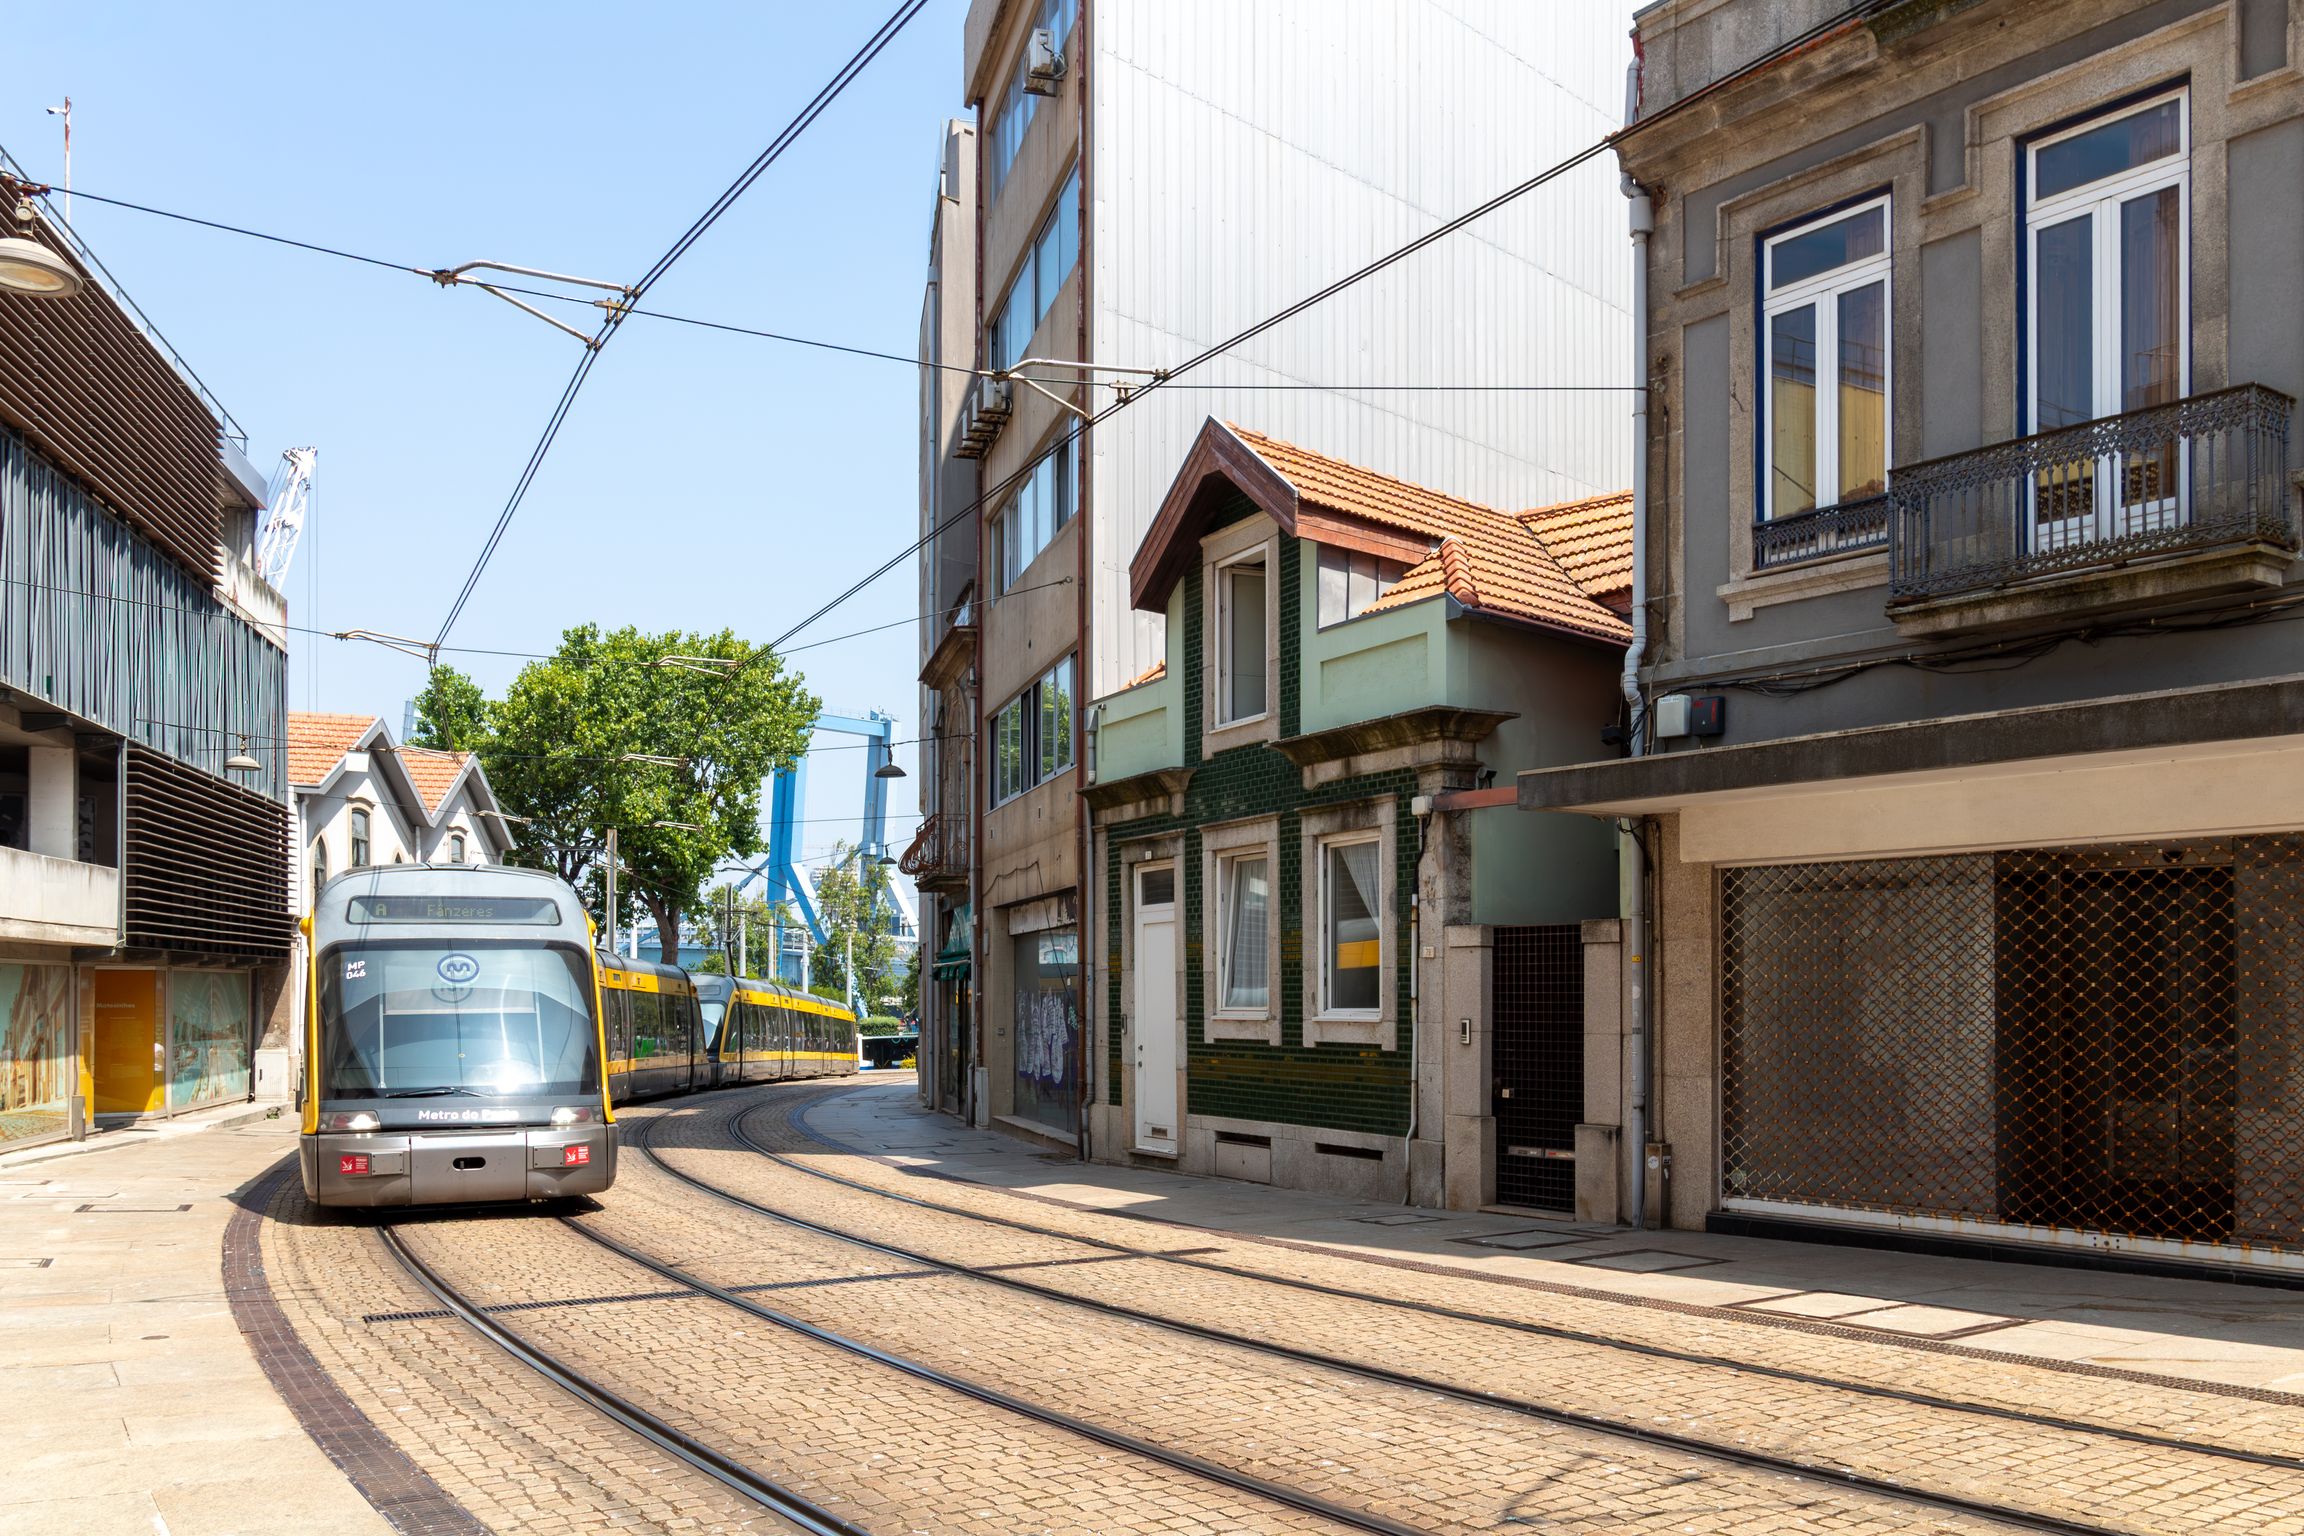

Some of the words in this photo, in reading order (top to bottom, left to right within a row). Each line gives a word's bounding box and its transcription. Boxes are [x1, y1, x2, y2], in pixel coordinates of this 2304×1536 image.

[376, 903, 387, 916] A
[347, 960, 366, 971] MP
[346, 969, 366, 980] 046
[418, 1109, 459, 1120] Metro
[461, 1109, 479, 1120] do
[481, 1108, 520, 1121] Pto
